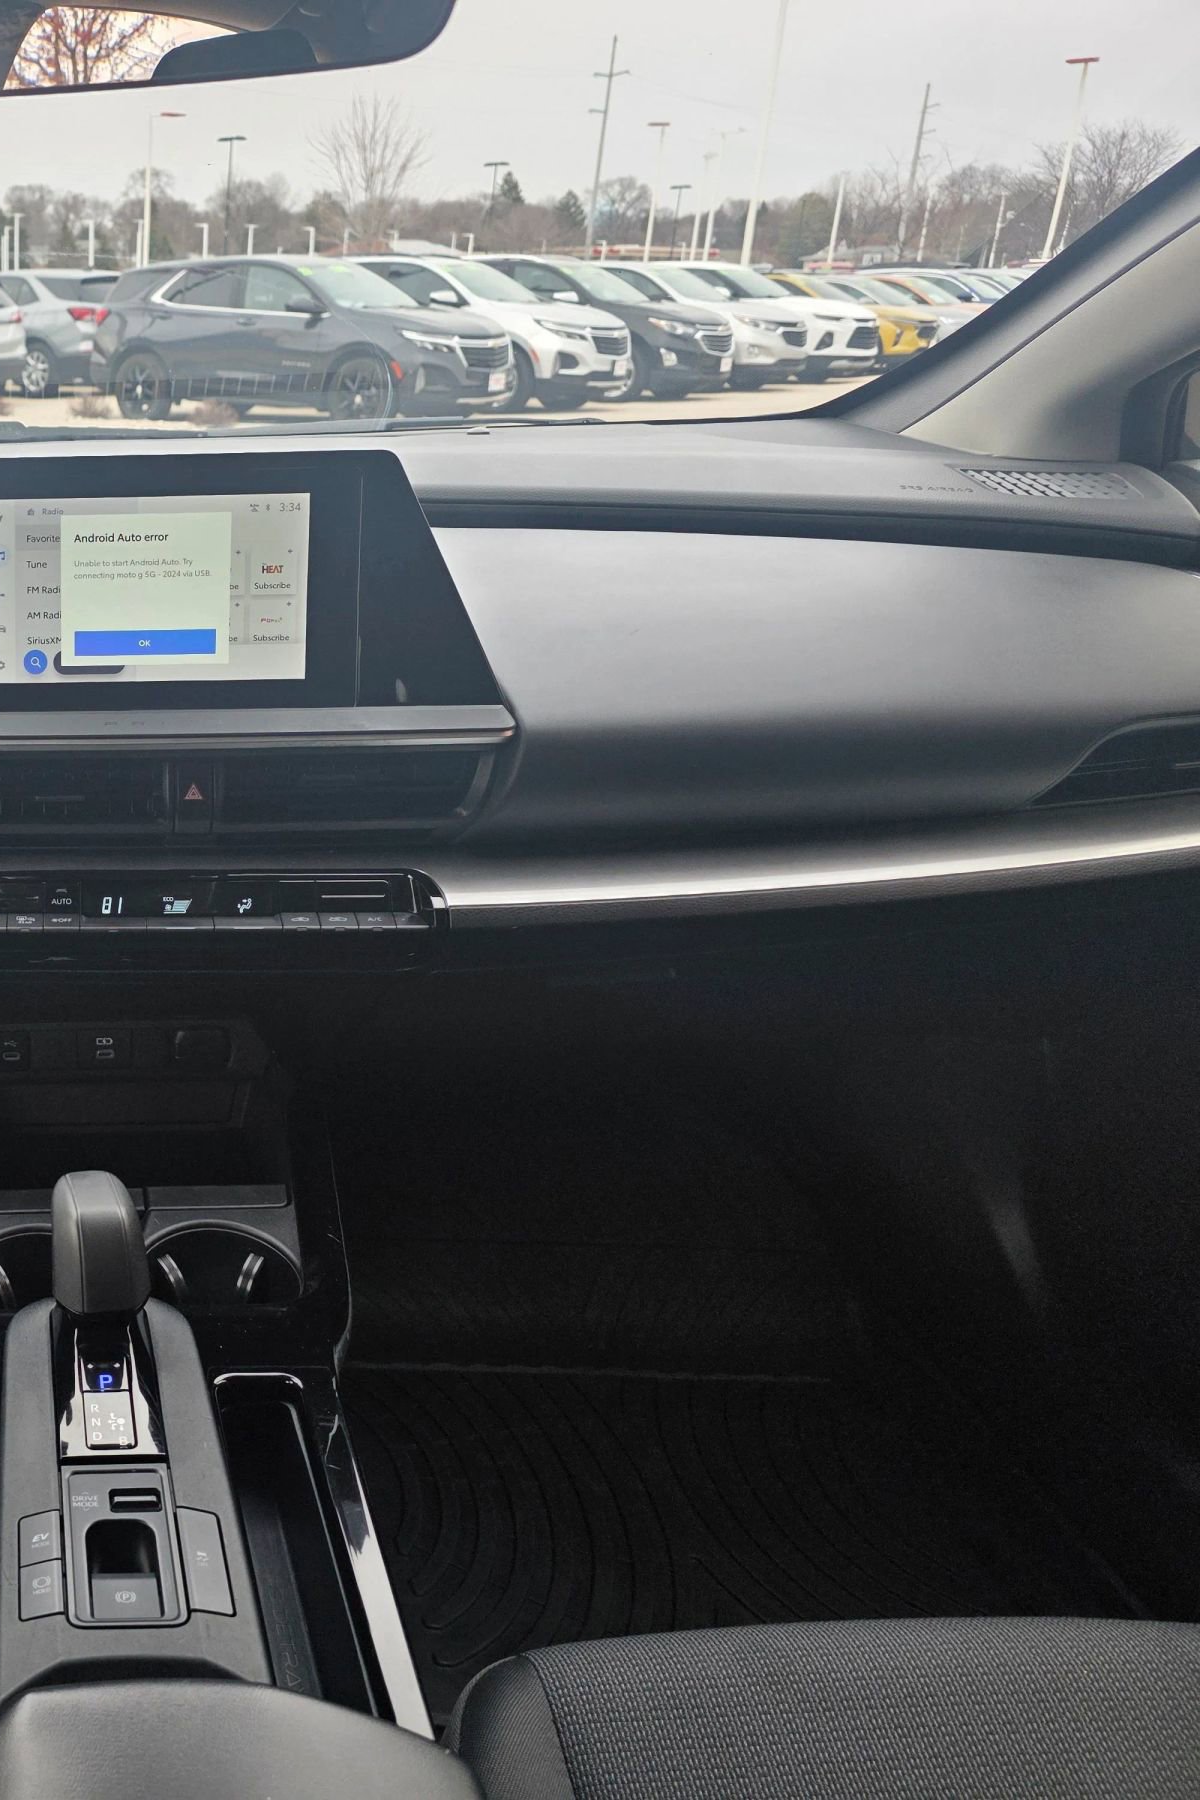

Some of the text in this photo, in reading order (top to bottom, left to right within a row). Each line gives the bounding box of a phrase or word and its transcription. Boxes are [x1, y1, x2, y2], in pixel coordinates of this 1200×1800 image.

[42, 508, 64, 516] Radio
[279, 503, 301, 512] 3:34
[74, 533, 168, 543] Android Auto error
[26, 560, 48, 569] Tune
[183, 558, 193, 567] Try
[262, 565, 284, 574] HEAT
[74, 572, 115, 580] connecting
[26, 586, 39, 594] FM
[26, 611, 41, 619] AM
[138, 639, 151, 647] OK
[51, 897, 72, 905] AUTO
[102, 896, 123, 914] 81
[99, 1374, 113, 1391] P
[90, 1404, 100, 1413] R
[91, 1417, 101, 1427] N
[92, 1431, 103, 1441] D
[119, 1436, 128, 1446] B
[32, 1532, 50, 1542] EV
